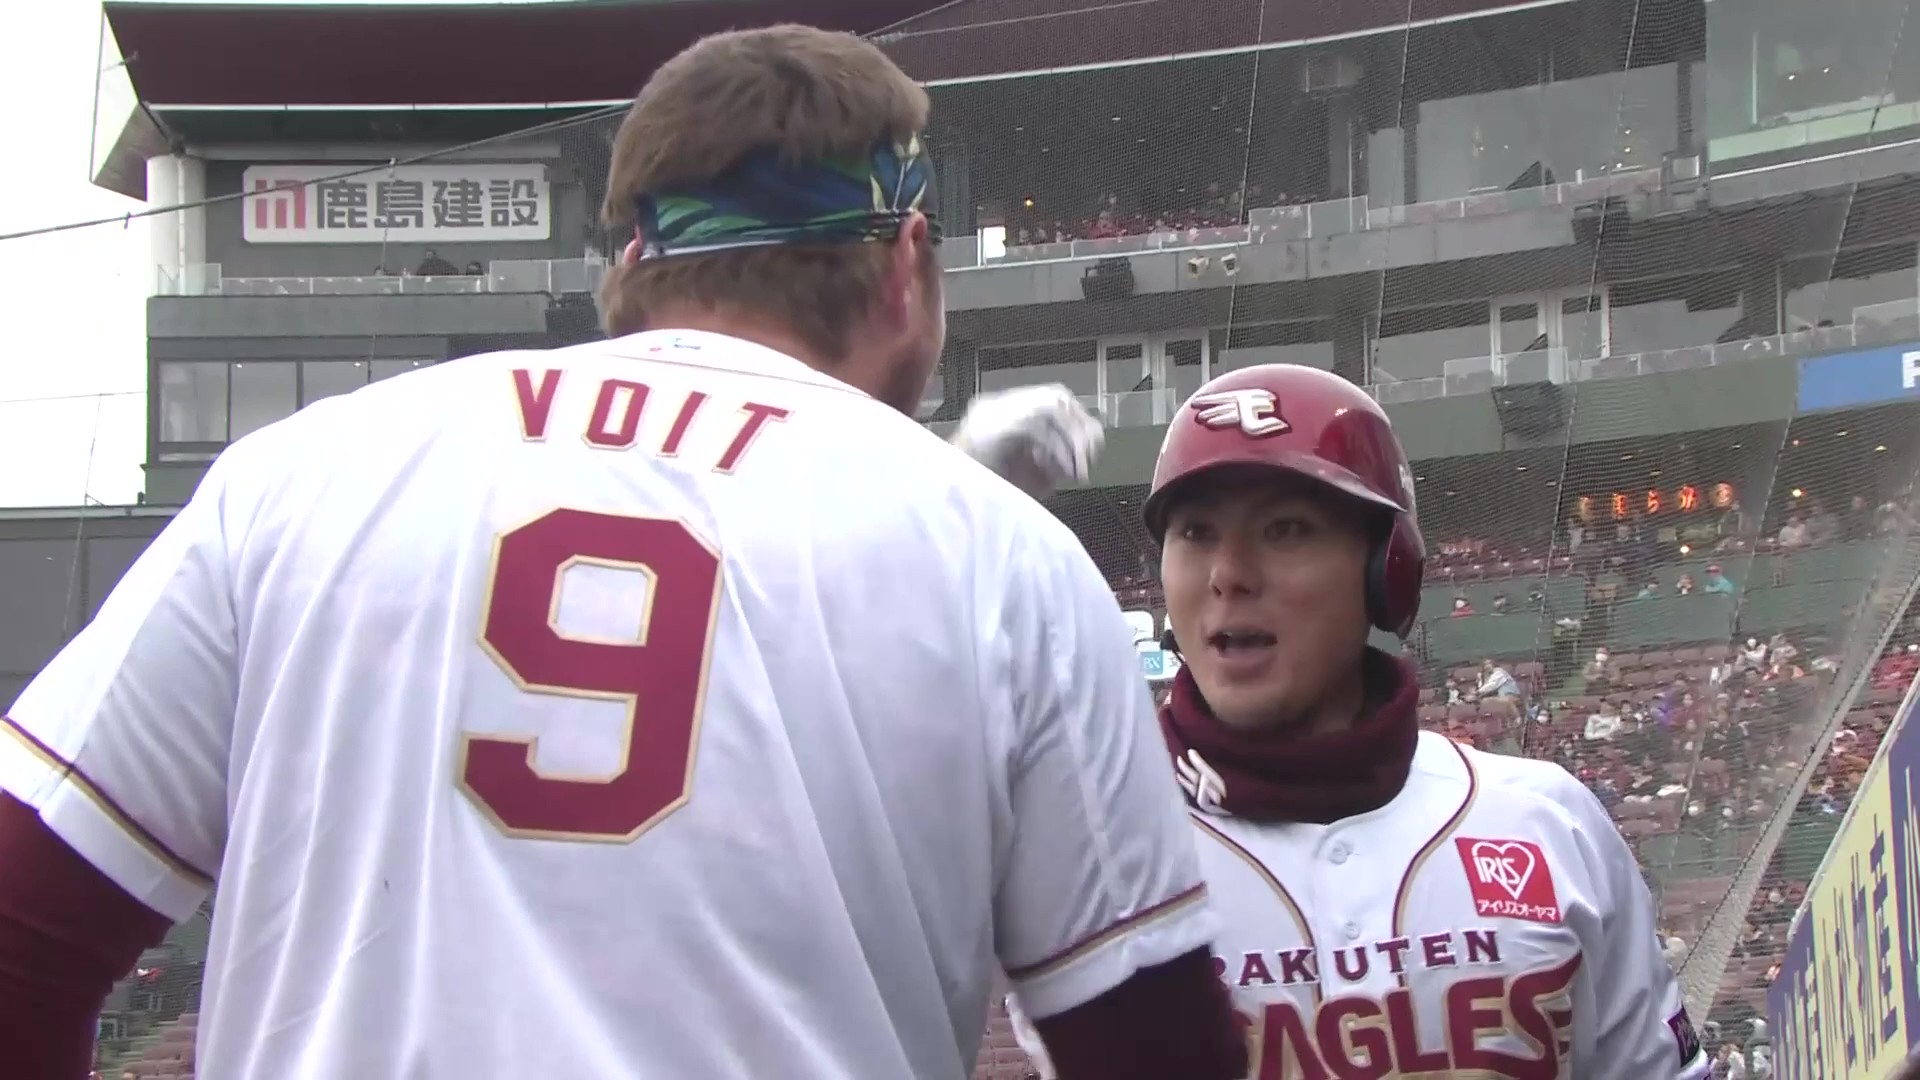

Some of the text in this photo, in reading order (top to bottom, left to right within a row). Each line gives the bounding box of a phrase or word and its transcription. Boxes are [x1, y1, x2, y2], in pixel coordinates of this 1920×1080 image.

[316, 178, 539, 229] 鹿島建設
[508, 368, 795, 476] VOIT
[455, 506, 725, 845] 9
[1472, 856, 1521, 884] IRIS
[1477, 899, 1556, 920] アイリスオーヤマ
[1231, 950, 1583, 1080] AGLES
